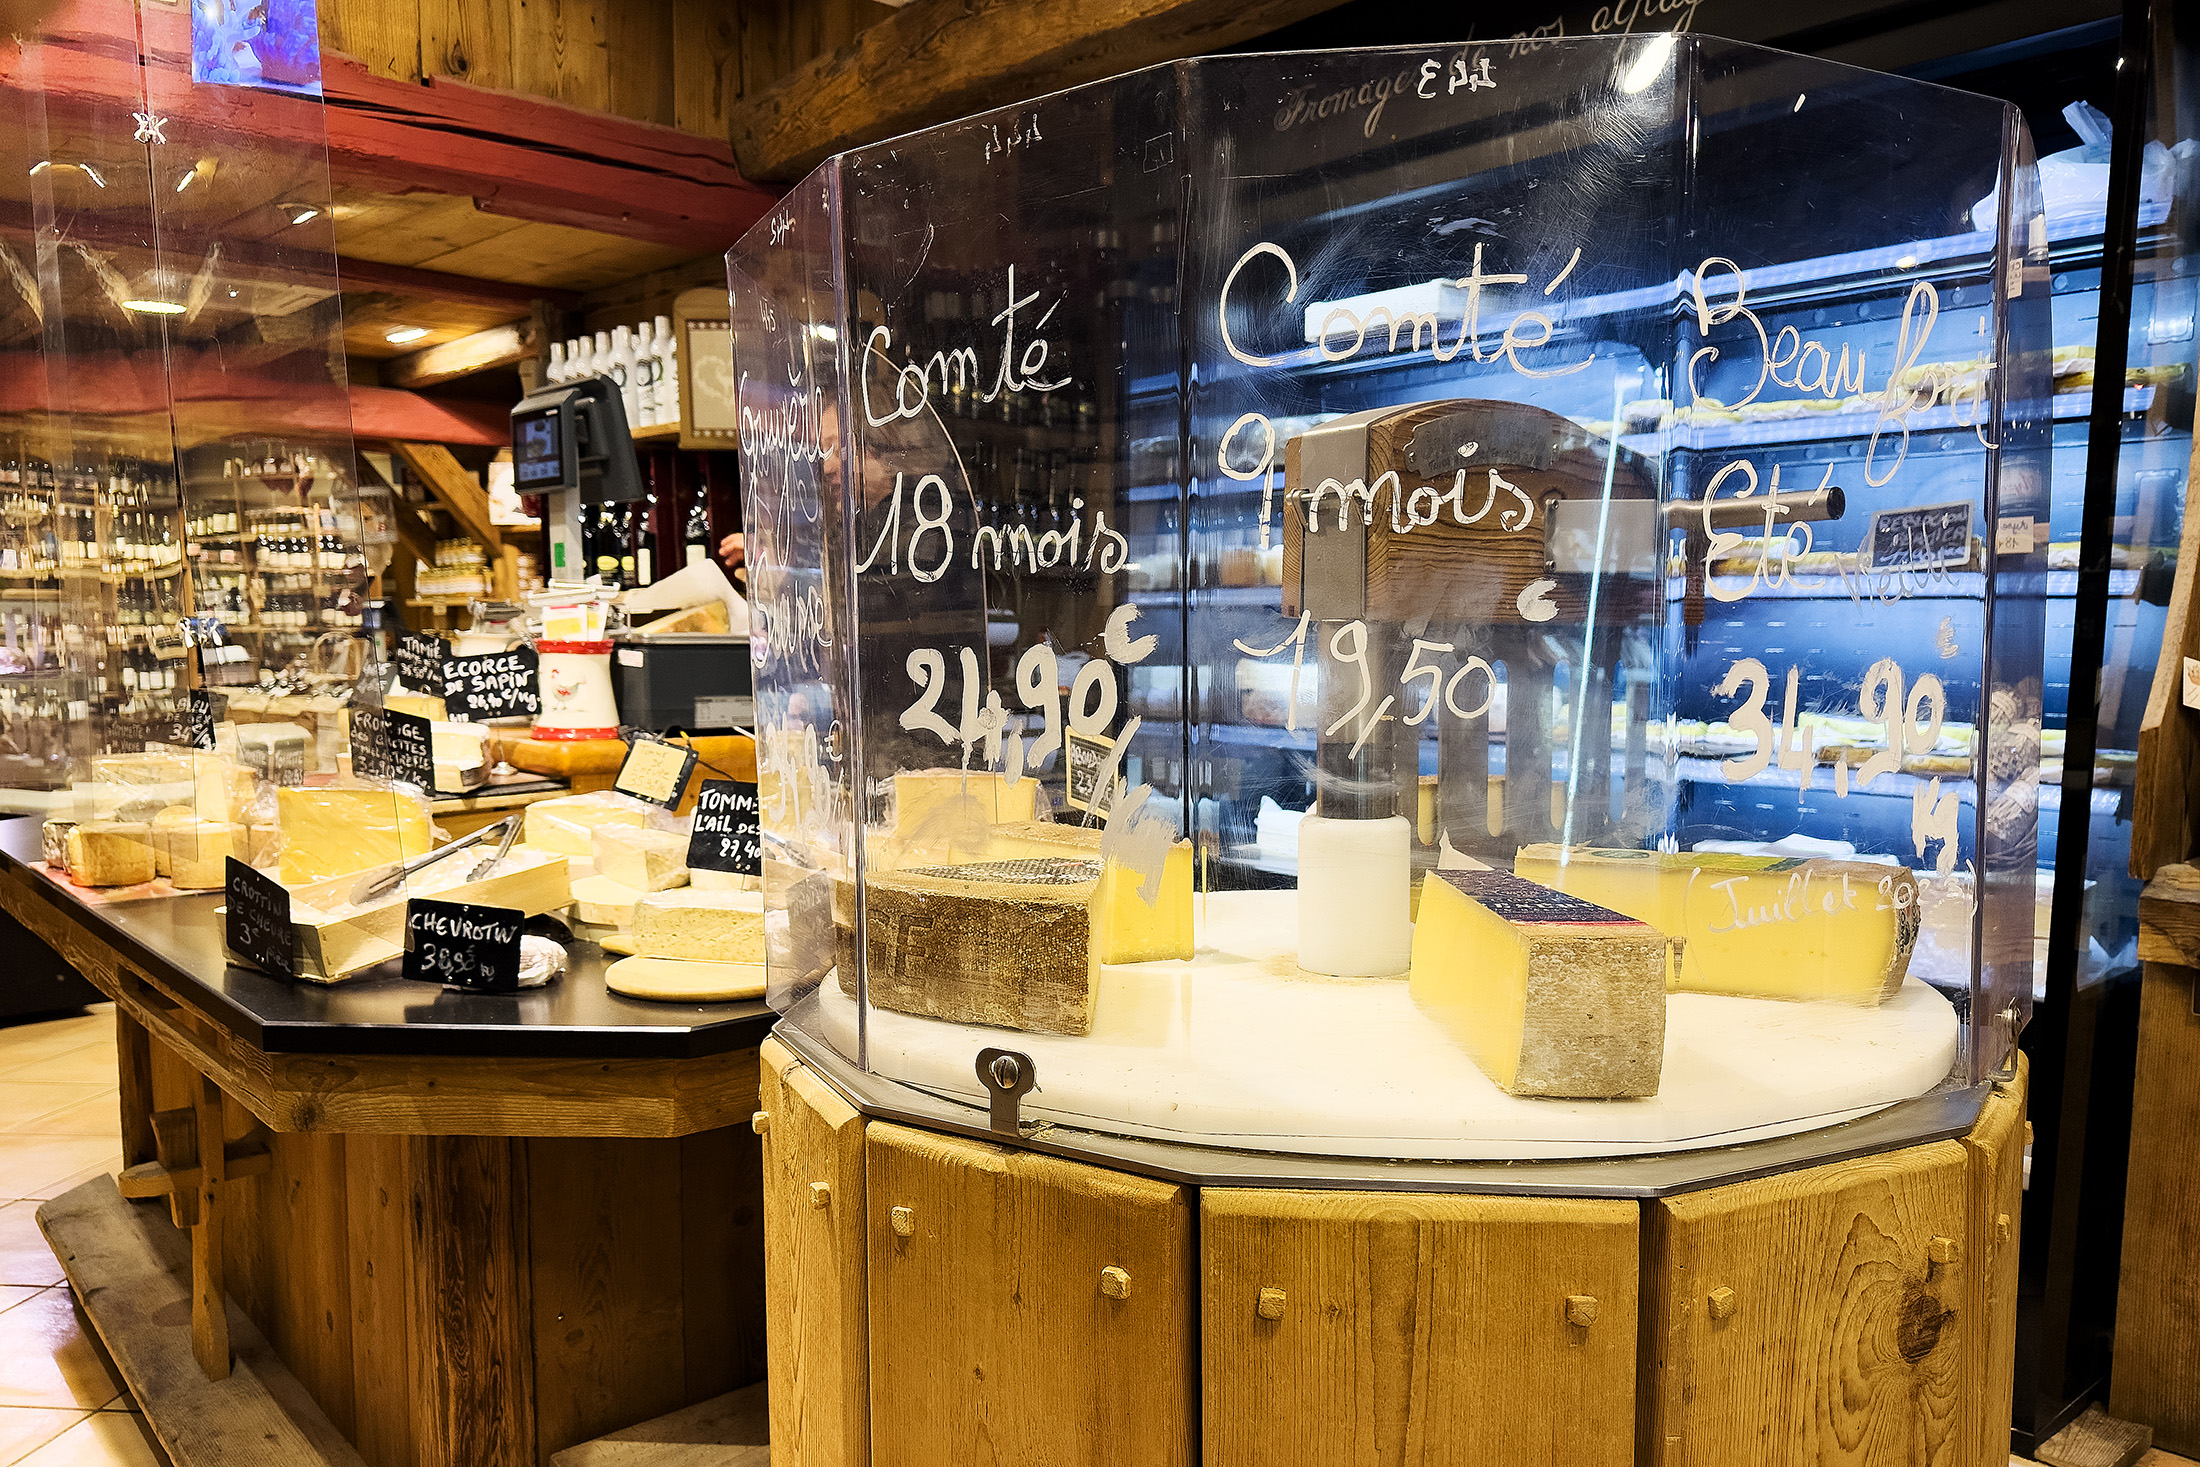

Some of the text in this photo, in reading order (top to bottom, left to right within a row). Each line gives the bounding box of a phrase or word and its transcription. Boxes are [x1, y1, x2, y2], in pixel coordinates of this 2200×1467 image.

[1509, 15, 1564, 60] nos
[862, 263, 1072, 428] Comté
[1219, 241, 1597, 380] Comté
[1217, 412, 1536, 550] 9 mois
[853, 472, 1129, 583] 18 mois
[442, 655, 526, 680] ECORCE
[443, 669, 535, 697] DE SAPIN
[1232, 609, 1497, 761] 19,50
[823, 718, 843, 763] €
[1710, 656, 1947, 803] 34,90
[227, 894, 244, 915] DE
[232, 876, 281, 917] CROTTIN
